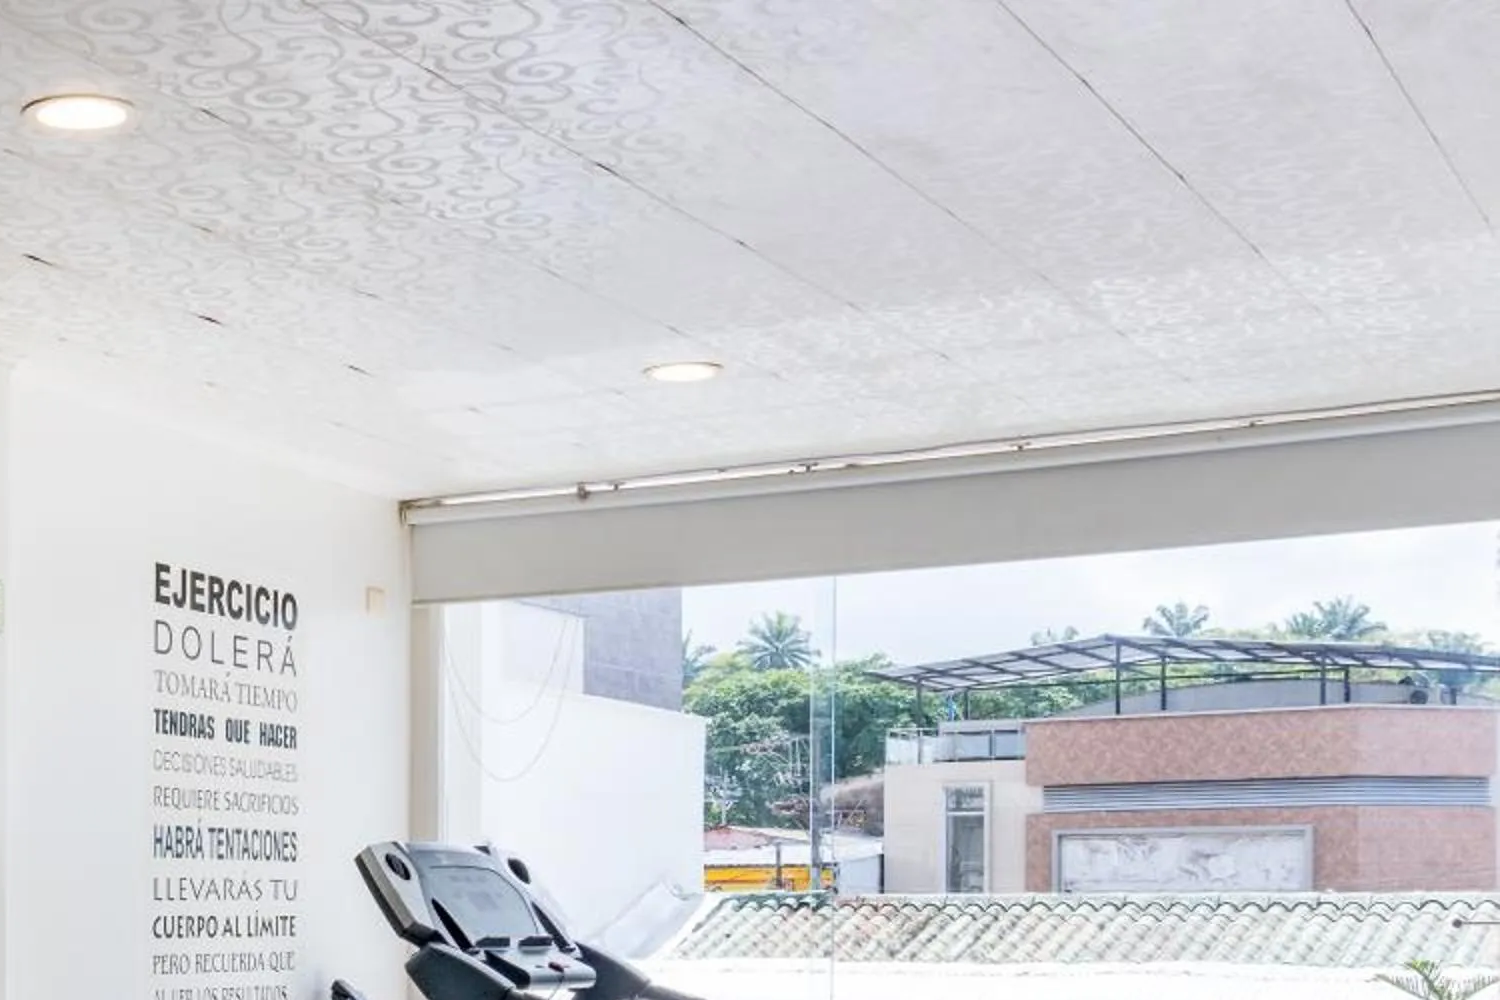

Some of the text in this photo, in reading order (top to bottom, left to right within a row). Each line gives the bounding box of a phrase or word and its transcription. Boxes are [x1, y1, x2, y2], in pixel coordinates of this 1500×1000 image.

[155, 562, 298, 631] EJERCICIO
[153, 619, 297, 677] DOLERÁ
[153, 669, 298, 713] TOMARÁ TIEMPO
[153, 708, 297, 750] TENDRAS QUE HACER
[153, 785, 299, 816] REQUIERE SACRIFICIOS
[153, 819, 298, 863] HABRÁ TENTACIONES
[269, 879, 298, 901] TU
[152, 915, 218, 939] CUERPO
[222, 916, 242, 938] AL
[153, 951, 296, 975] PERO RECUERDA QUE
